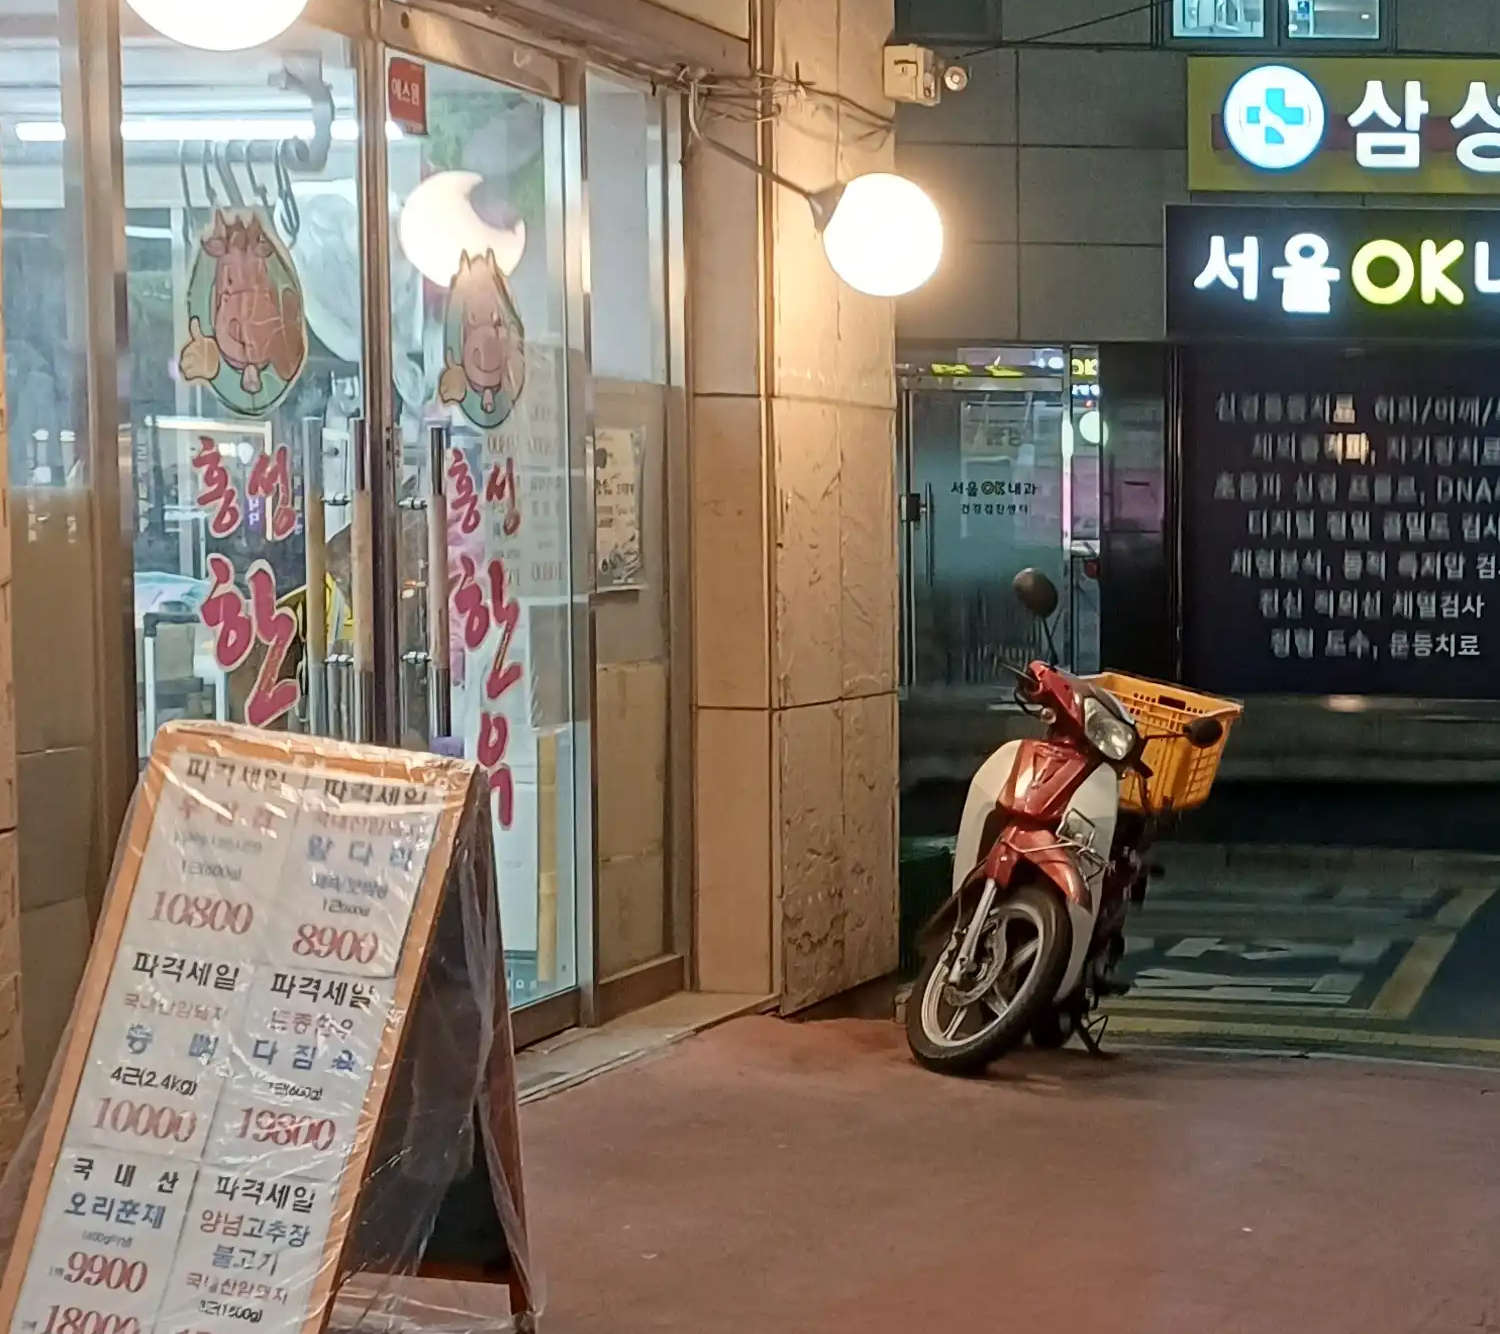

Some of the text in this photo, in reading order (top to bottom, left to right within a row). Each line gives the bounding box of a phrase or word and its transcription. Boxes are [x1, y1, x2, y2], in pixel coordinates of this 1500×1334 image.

[391, 76, 420, 107] 에스원
[149, 889, 255, 936] 10800
[291, 922, 380, 966] 8900
[131, 950, 240, 992] 파격세일
[269, 971, 377, 1010] 파격세일
[92, 1095, 198, 1144] 10000
[63, 1191, 168, 1231] 오리훈제
[213, 1174, 318, 1214] 파격세일
[198, 1208, 311, 1249] 양념고추장
[63, 1250, 149, 1294] 9900
[211, 1243, 281, 1277] 불고기
